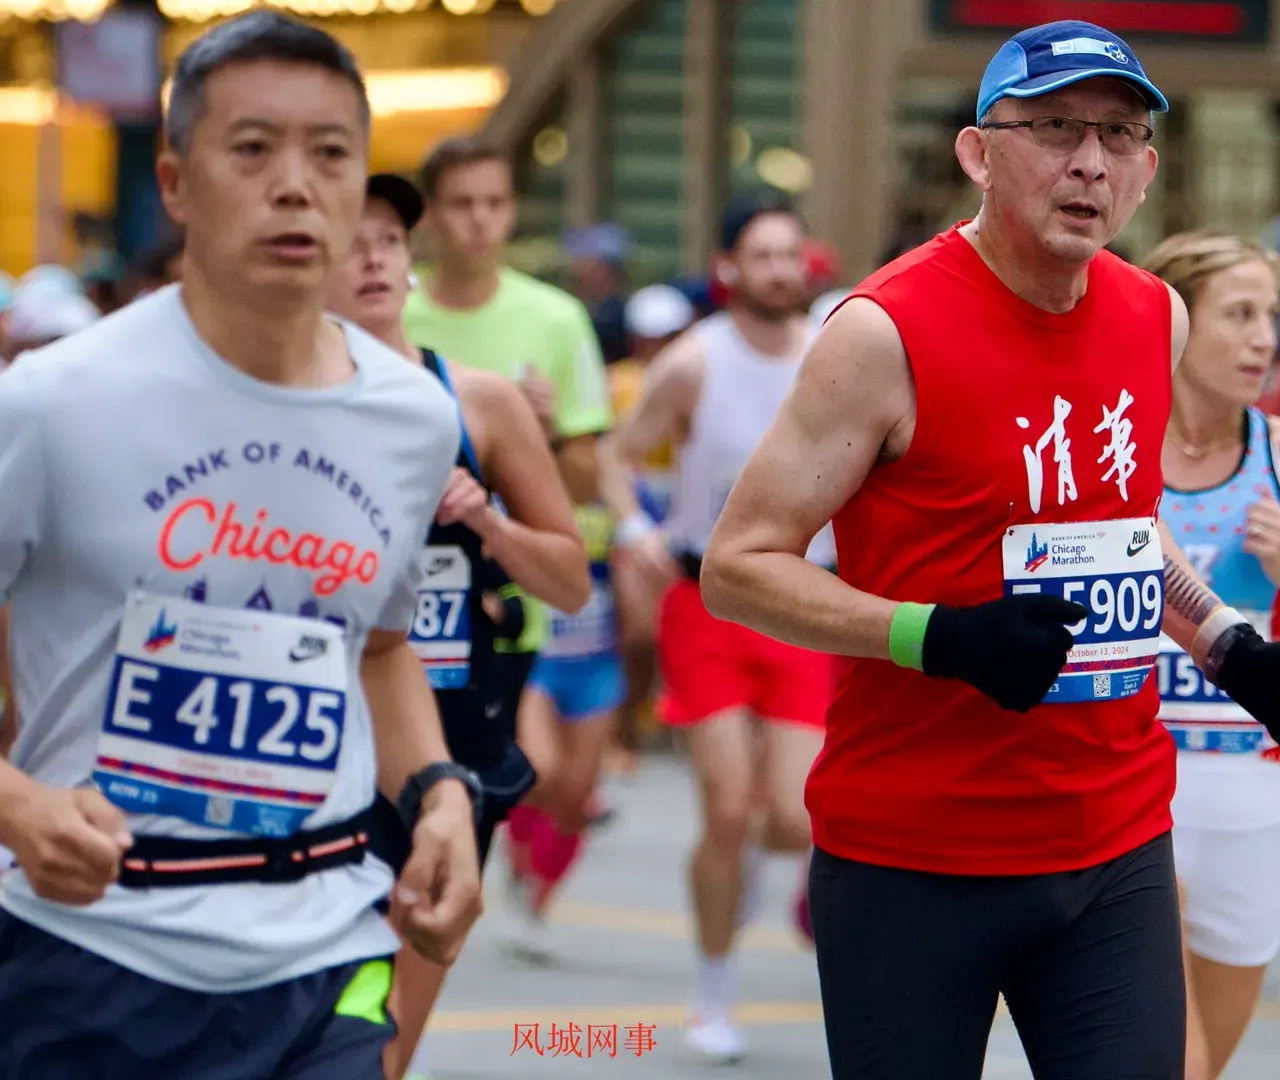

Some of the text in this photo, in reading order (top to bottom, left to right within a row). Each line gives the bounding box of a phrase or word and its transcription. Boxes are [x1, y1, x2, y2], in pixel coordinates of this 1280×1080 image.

[1015, 387, 1138, 515] 清華
[143, 441, 391, 550] BANK OF AMERICA
[157, 497, 379, 598] Chicago
[1051, 544, 1086, 556] Chicago
[1052, 555, 1095, 566] Marathon
[1131, 530, 1150, 545] RUN
[413, 592, 466, 638] 87
[1063, 574, 1162, 637] 5909
[1067, 648, 1097, 658] October
[1112, 646, 1129, 655] 2024
[112, 661, 342, 762] E 4125
